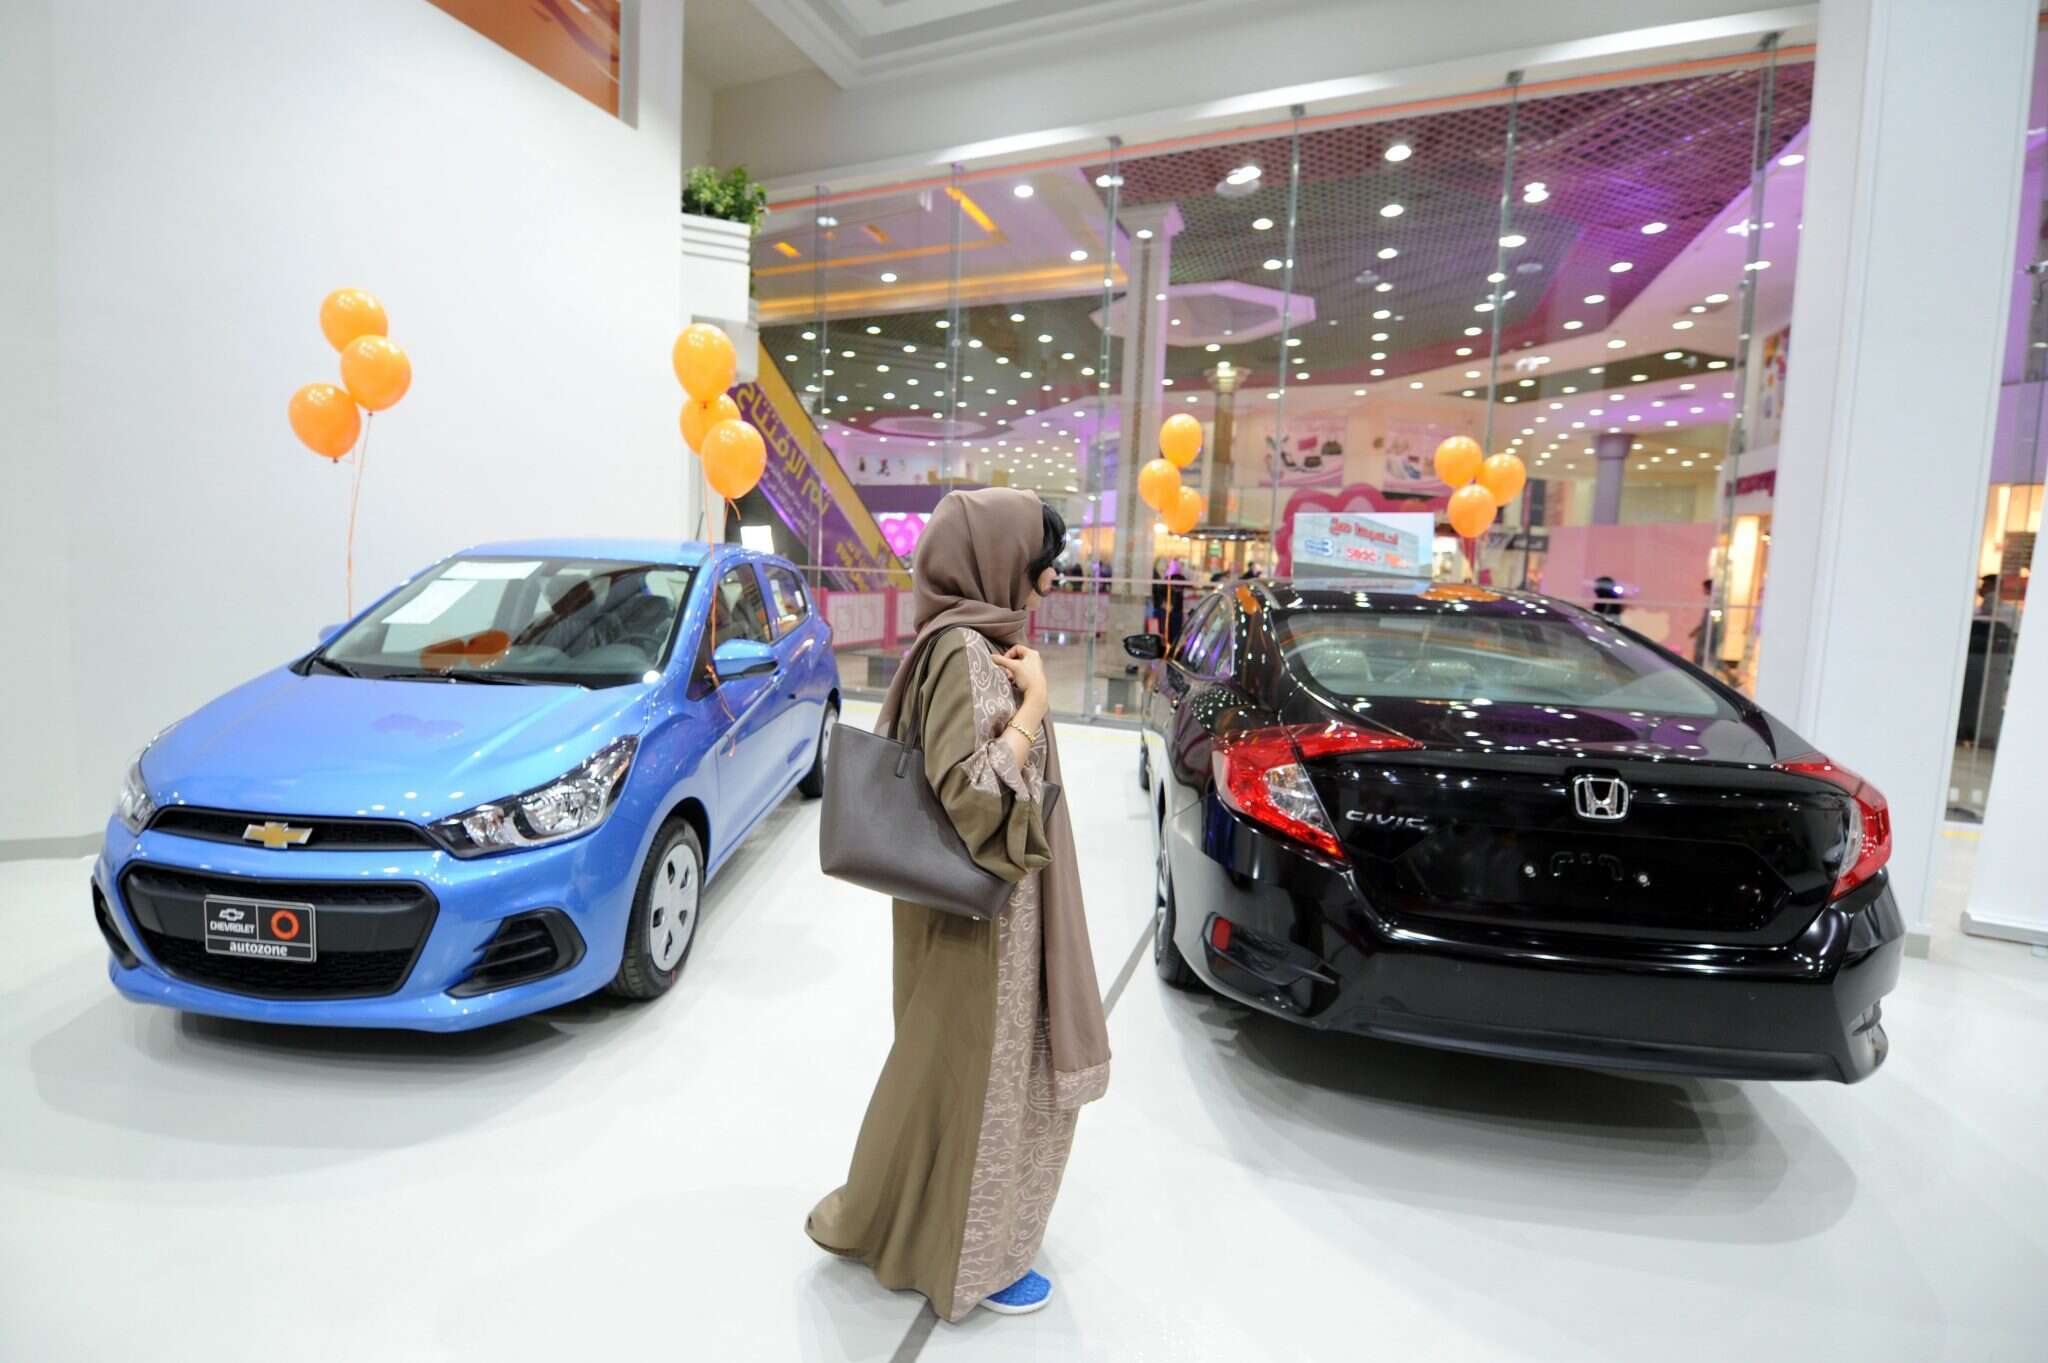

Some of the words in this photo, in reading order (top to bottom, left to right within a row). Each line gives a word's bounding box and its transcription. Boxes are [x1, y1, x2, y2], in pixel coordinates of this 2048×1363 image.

[1344, 809, 1428, 831] CIVIC
[209, 920, 256, 934] CHEVROLET
[229, 941, 288, 956] autozone
